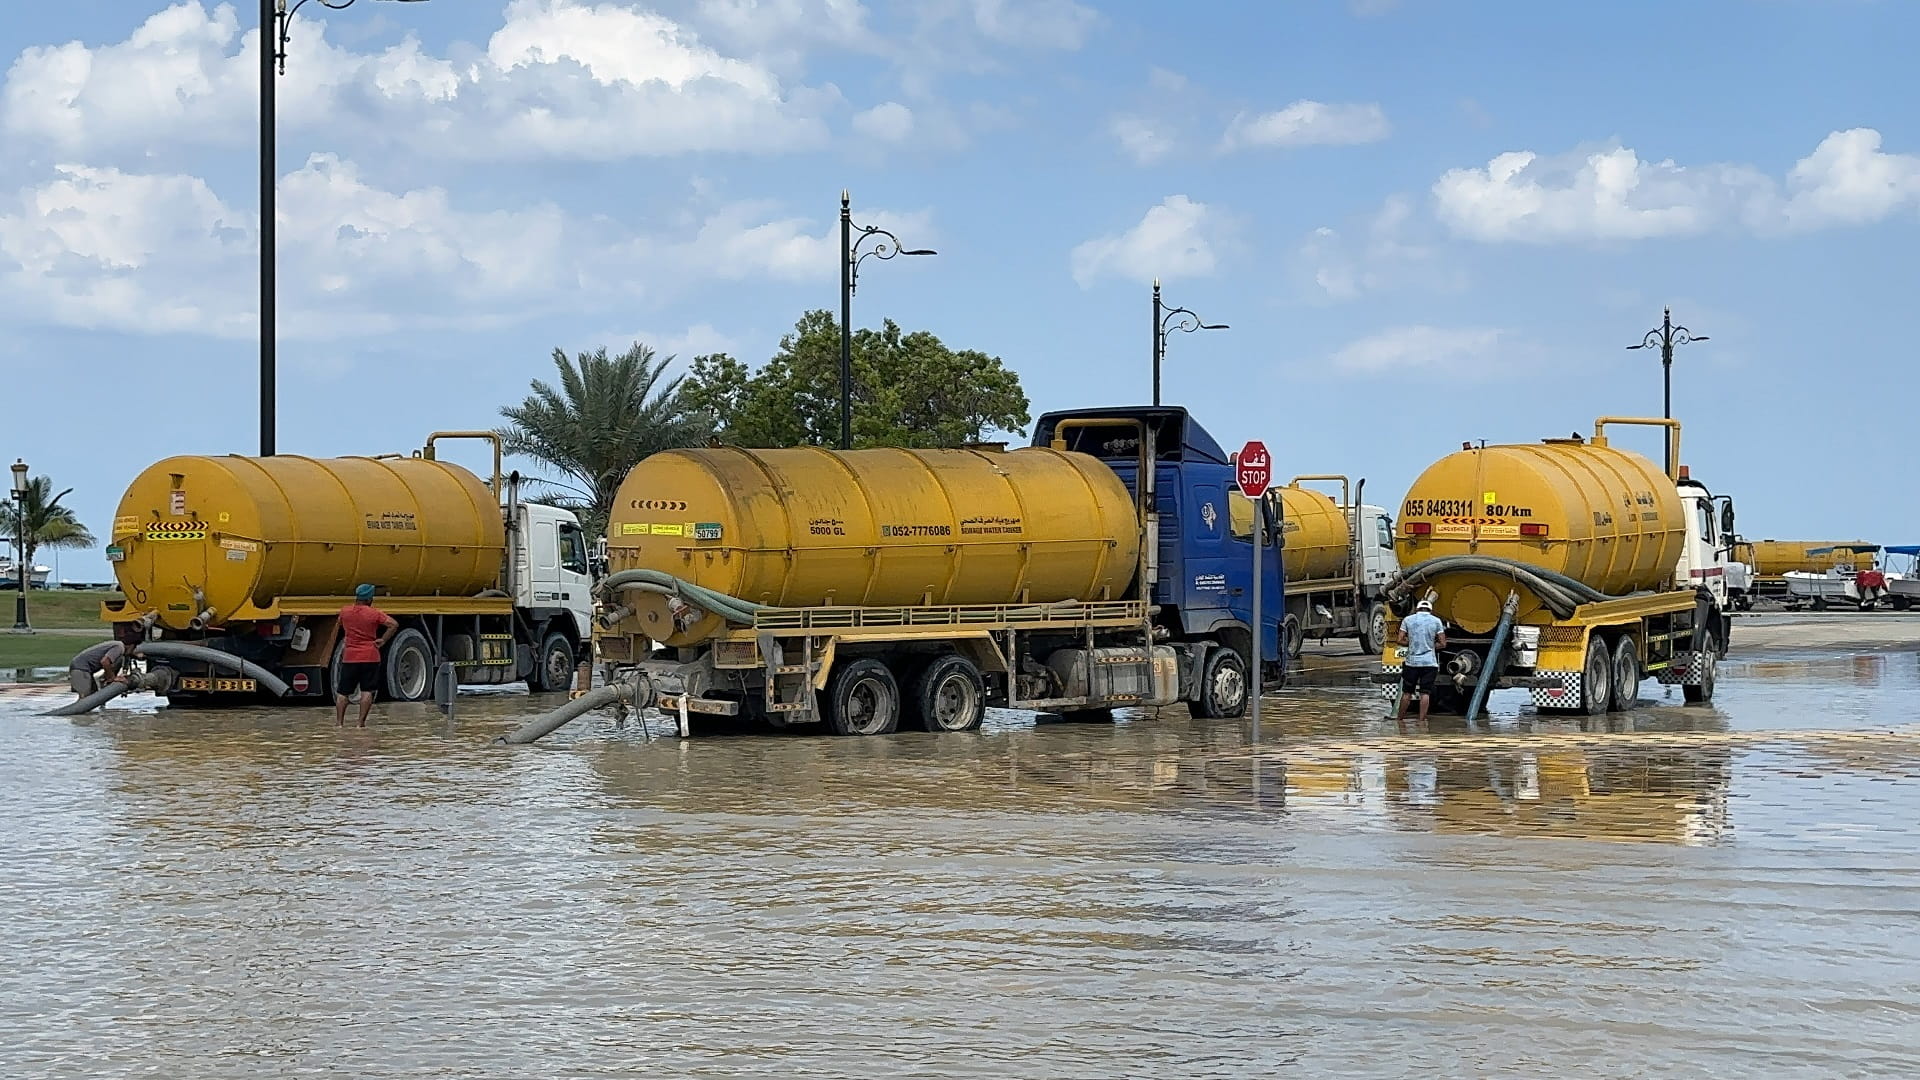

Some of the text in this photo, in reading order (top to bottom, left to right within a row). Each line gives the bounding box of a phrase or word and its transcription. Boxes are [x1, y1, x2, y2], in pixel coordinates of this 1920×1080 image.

[1243, 449, 1265, 466] قف
[1242, 470, 1266, 484] STOP
[1405, 500, 1473, 517] 055 8483311
[1486, 504, 1532, 517] 80/km
[810, 527, 846, 535] 5000 GL
[892, 526, 951, 536] 052-7776086
